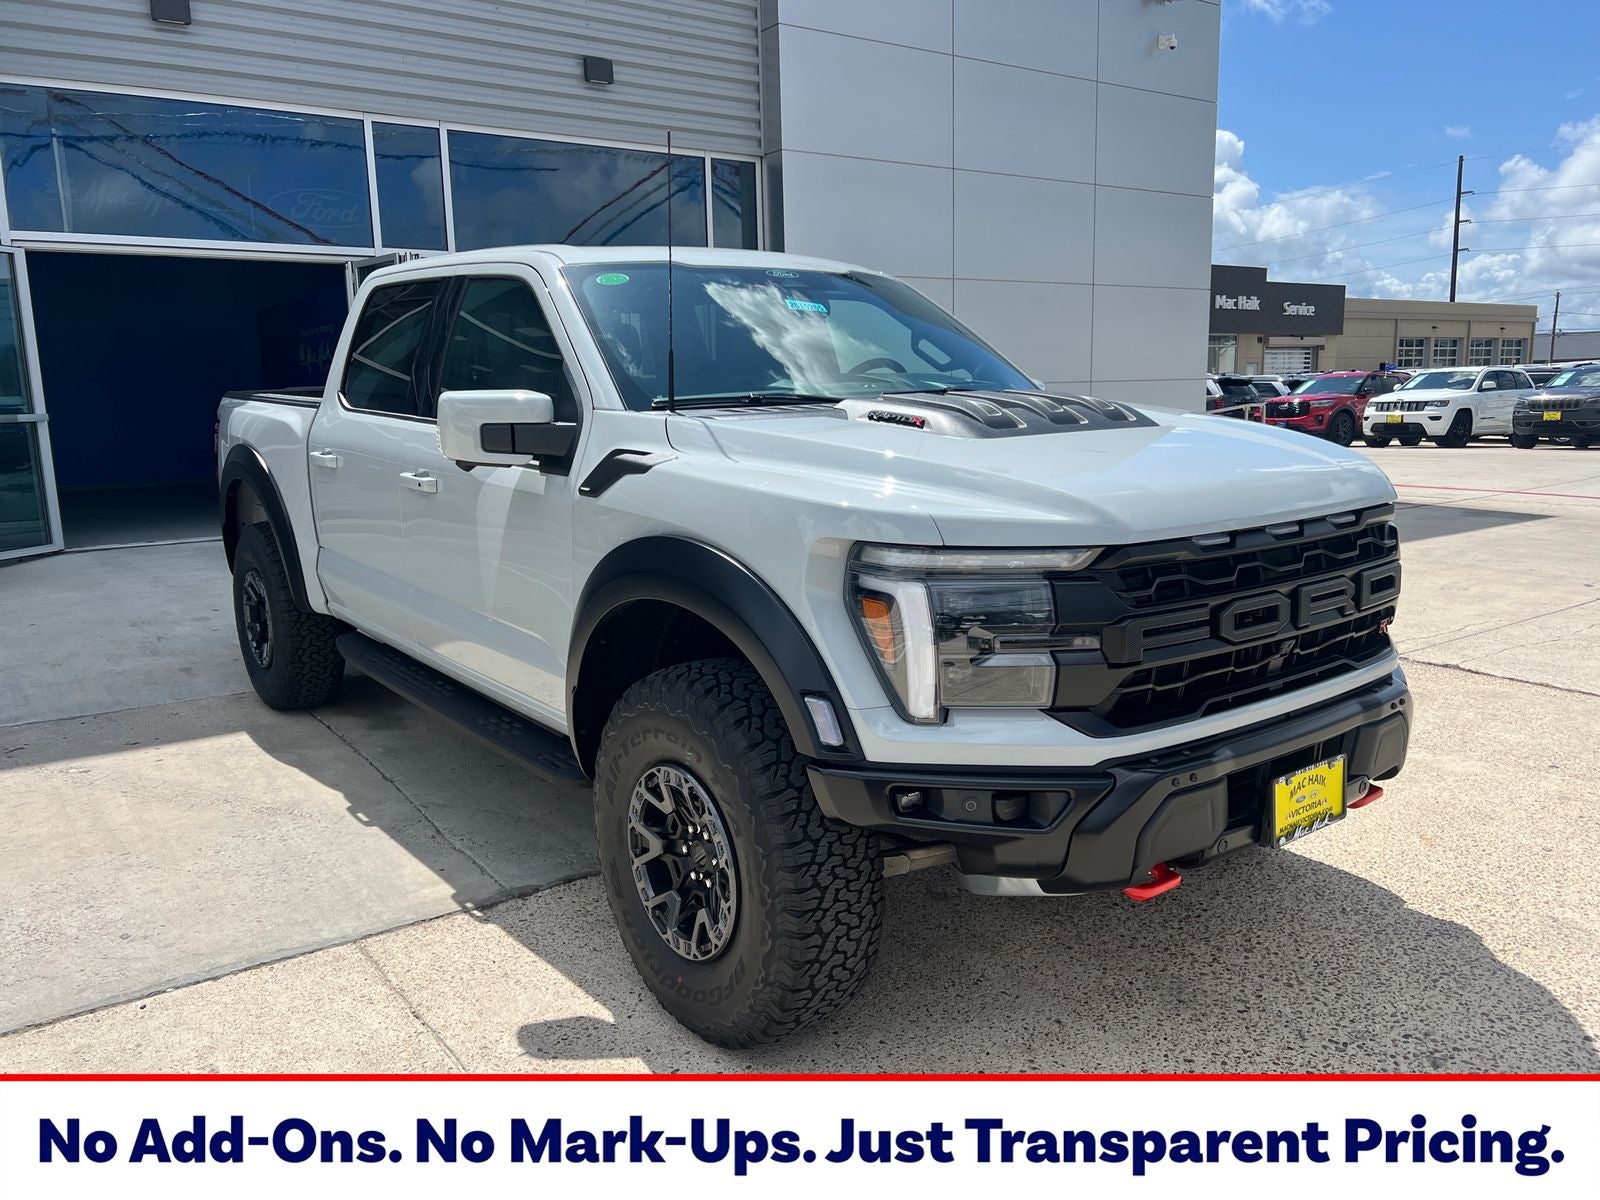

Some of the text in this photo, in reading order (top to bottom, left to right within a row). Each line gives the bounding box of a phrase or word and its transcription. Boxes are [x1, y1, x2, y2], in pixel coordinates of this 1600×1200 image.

[291, 193, 360, 223] Ford
[1215, 294, 1260, 311] Mac Haik
[1282, 301, 1316, 316] Service
[1104, 561, 1402, 665] FORD
[1289, 777, 1307, 801] MAC
[1307, 774, 1327, 788] HAIK
